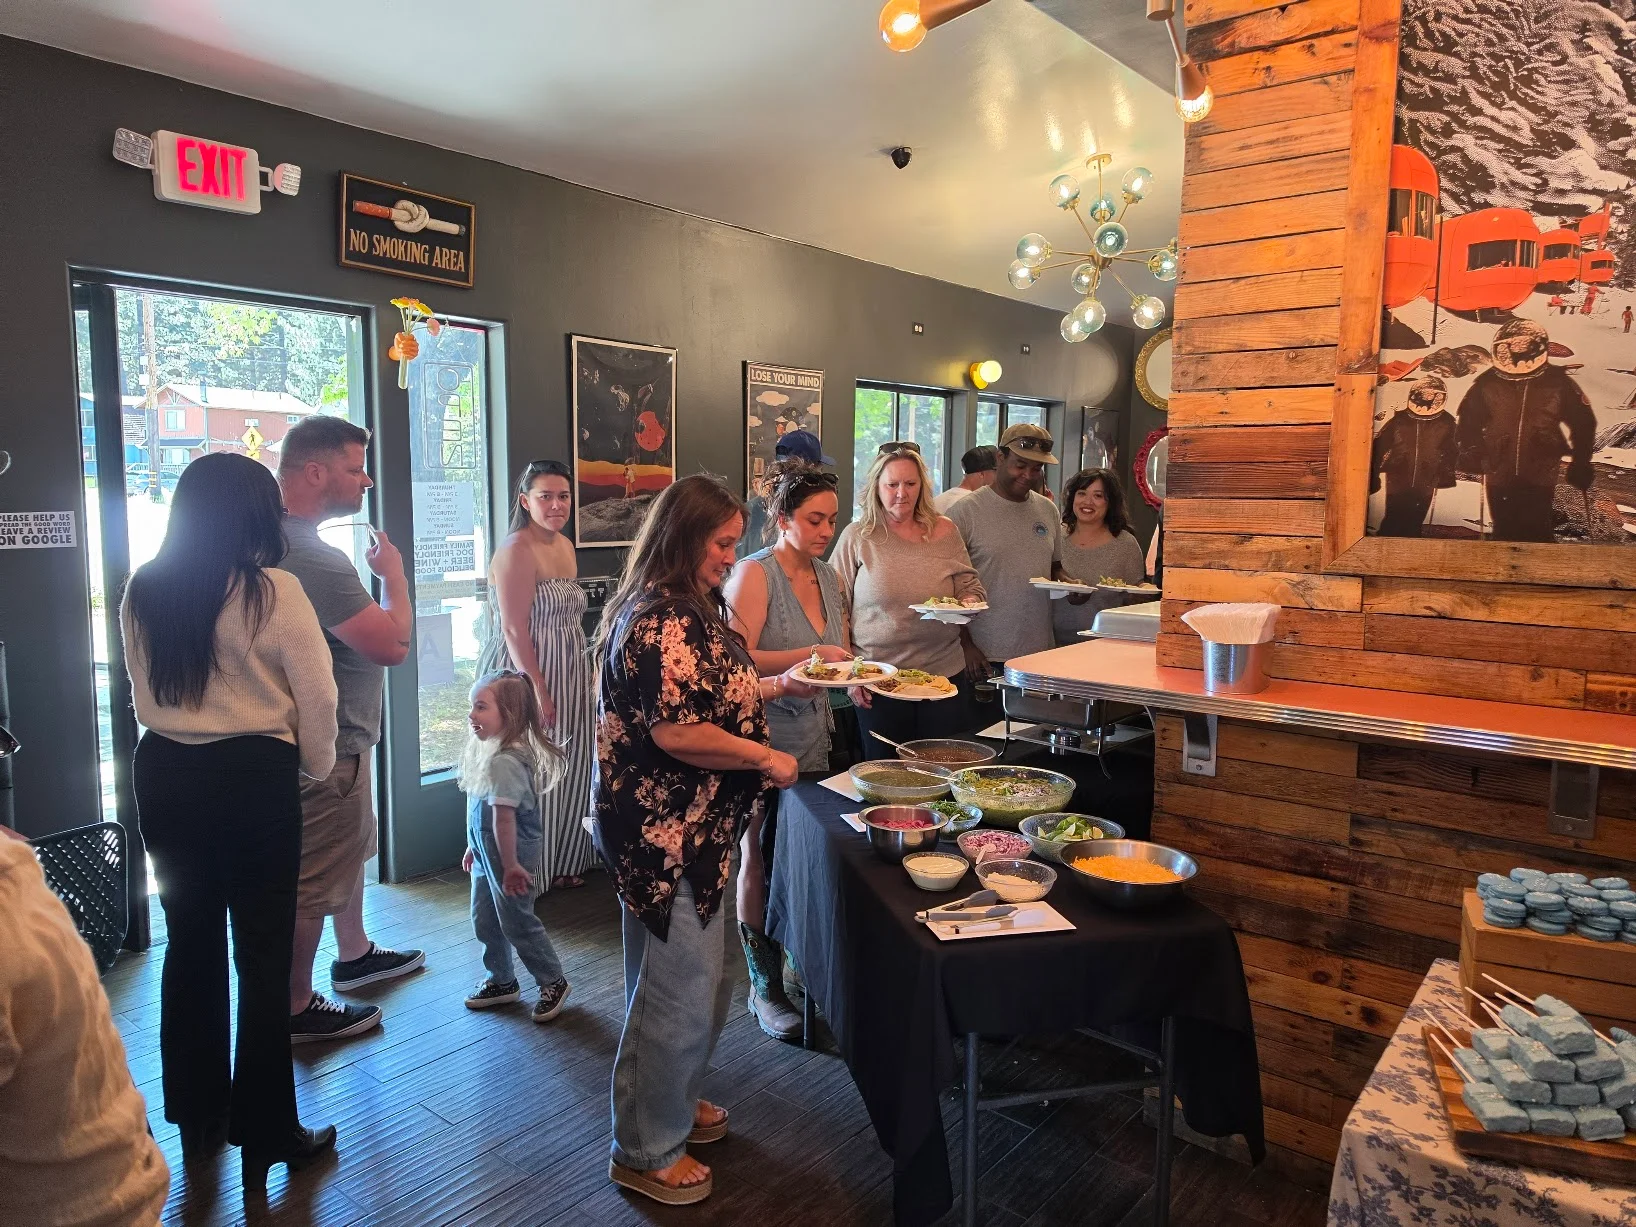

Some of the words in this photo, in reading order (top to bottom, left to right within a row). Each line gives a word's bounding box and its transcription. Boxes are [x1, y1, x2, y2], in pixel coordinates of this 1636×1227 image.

[176, 137, 248, 202] EXIT
[349, 228, 369, 254] NO
[372, 234, 430, 265] SMOKING
[432, 246, 466, 272] AREA
[751, 368, 772, 383] LOSE
[773, 372, 796, 385] YOUR
[797, 375, 820, 388] MIND
[0, 535, 16, 546] ON
[21, 534, 72, 545] GOOGLE
